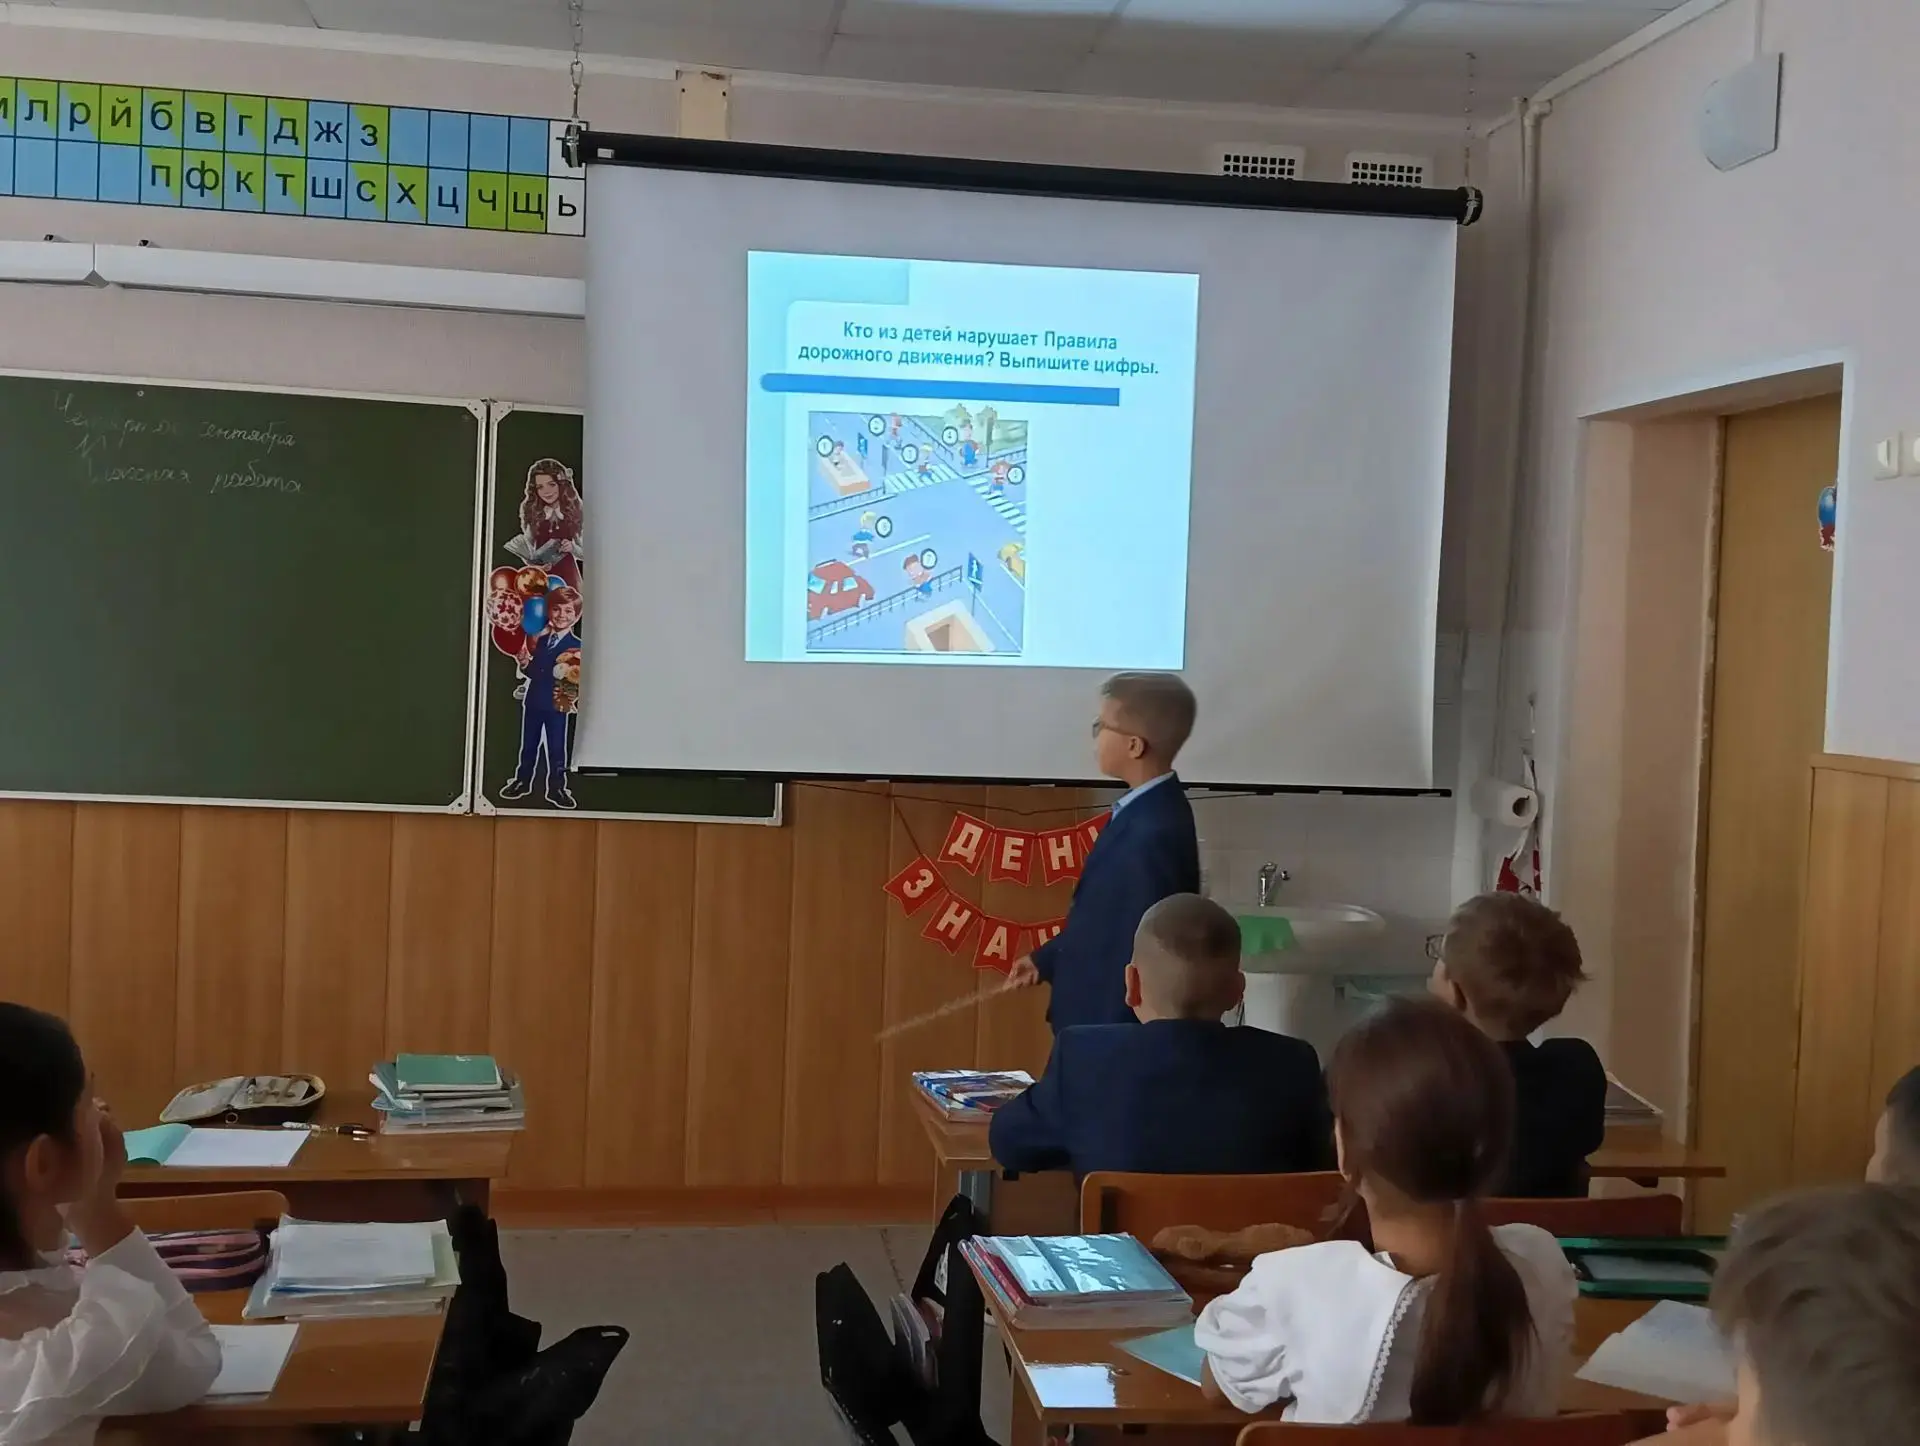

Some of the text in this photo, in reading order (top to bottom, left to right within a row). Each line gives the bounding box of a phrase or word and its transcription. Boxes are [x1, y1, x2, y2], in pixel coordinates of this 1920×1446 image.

[24, 99, 48, 122] л
[69, 102, 91, 132] р
[110, 97, 132, 128] й
[150, 100, 173, 131] б
[195, 111, 216, 134] в
[238, 114, 253, 136] г
[273, 117, 299, 146] д
[313, 120, 343, 143] ж
[359, 124, 378, 146] з
[151, 160, 577, 221] п ф к т ш с х ц ч щ ь
[843, 321, 1118, 352] Кто из детей нарушает Правила
[797, 346, 1159, 376] дорожного движения? Выпишите цифры.
[208, 458, 304, 495] работа
[947, 822, 1099, 871] ДЕН
